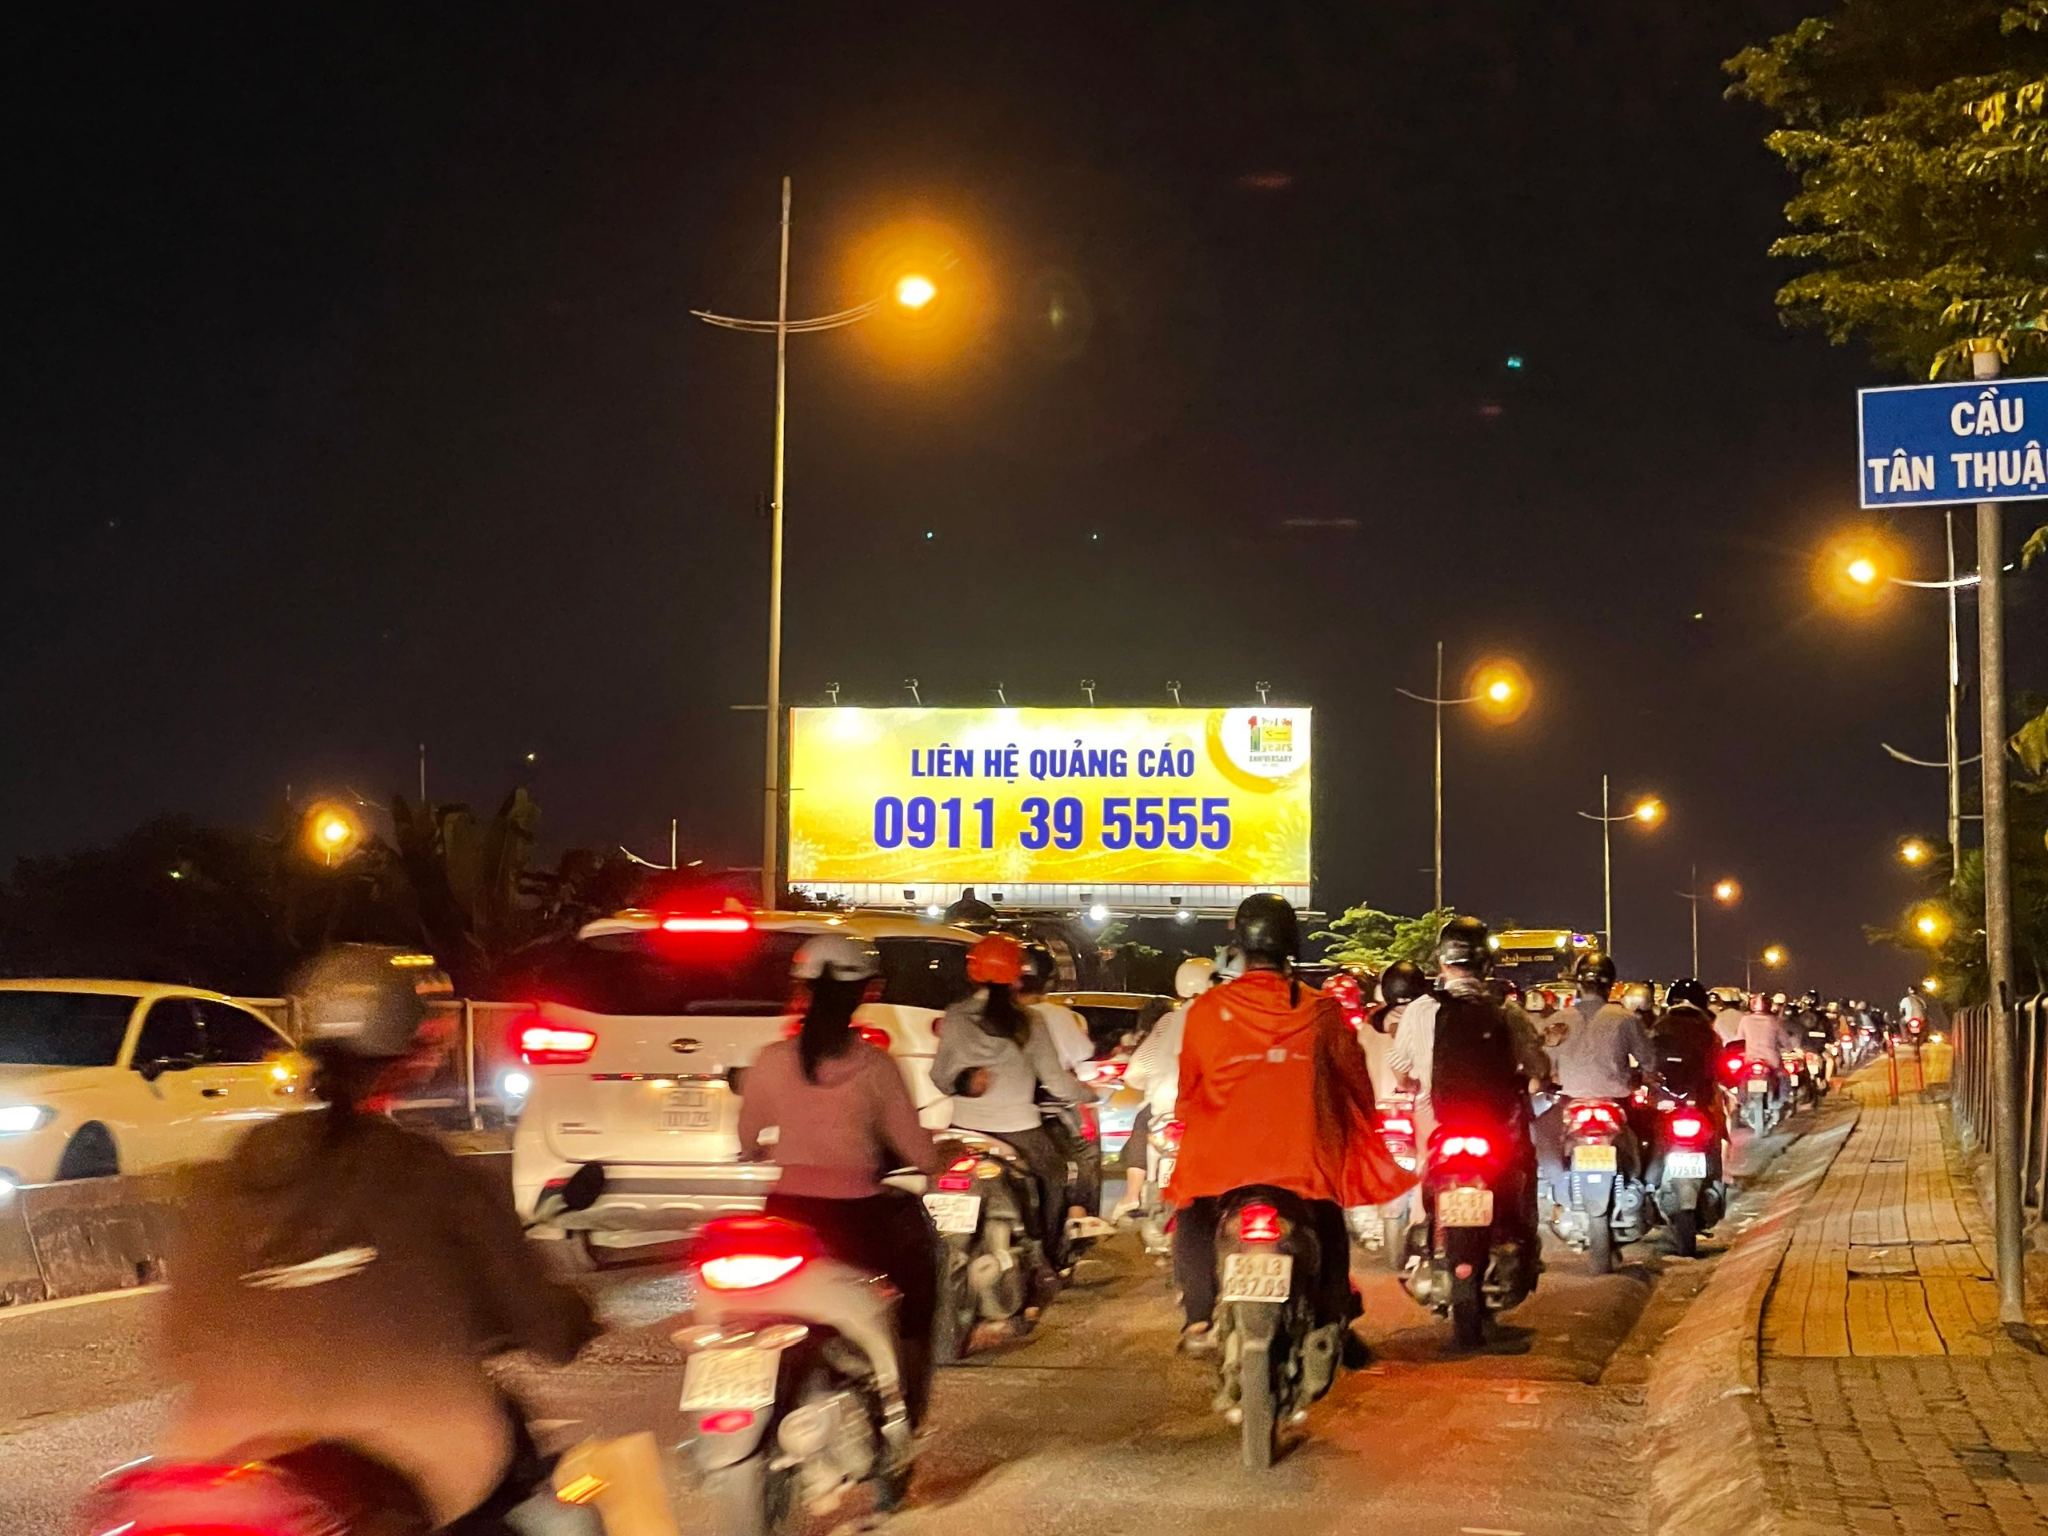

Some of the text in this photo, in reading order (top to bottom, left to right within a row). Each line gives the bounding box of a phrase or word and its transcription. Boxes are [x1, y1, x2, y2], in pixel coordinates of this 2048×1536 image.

[1950, 386, 2025, 437] CẦU
[1867, 439, 2048, 494] TÂN THUẬ
[911, 738, 1195, 784] LIÊN HỆ QUẢNG CÁO
[873, 796, 1231, 850] 0911 39 5555
